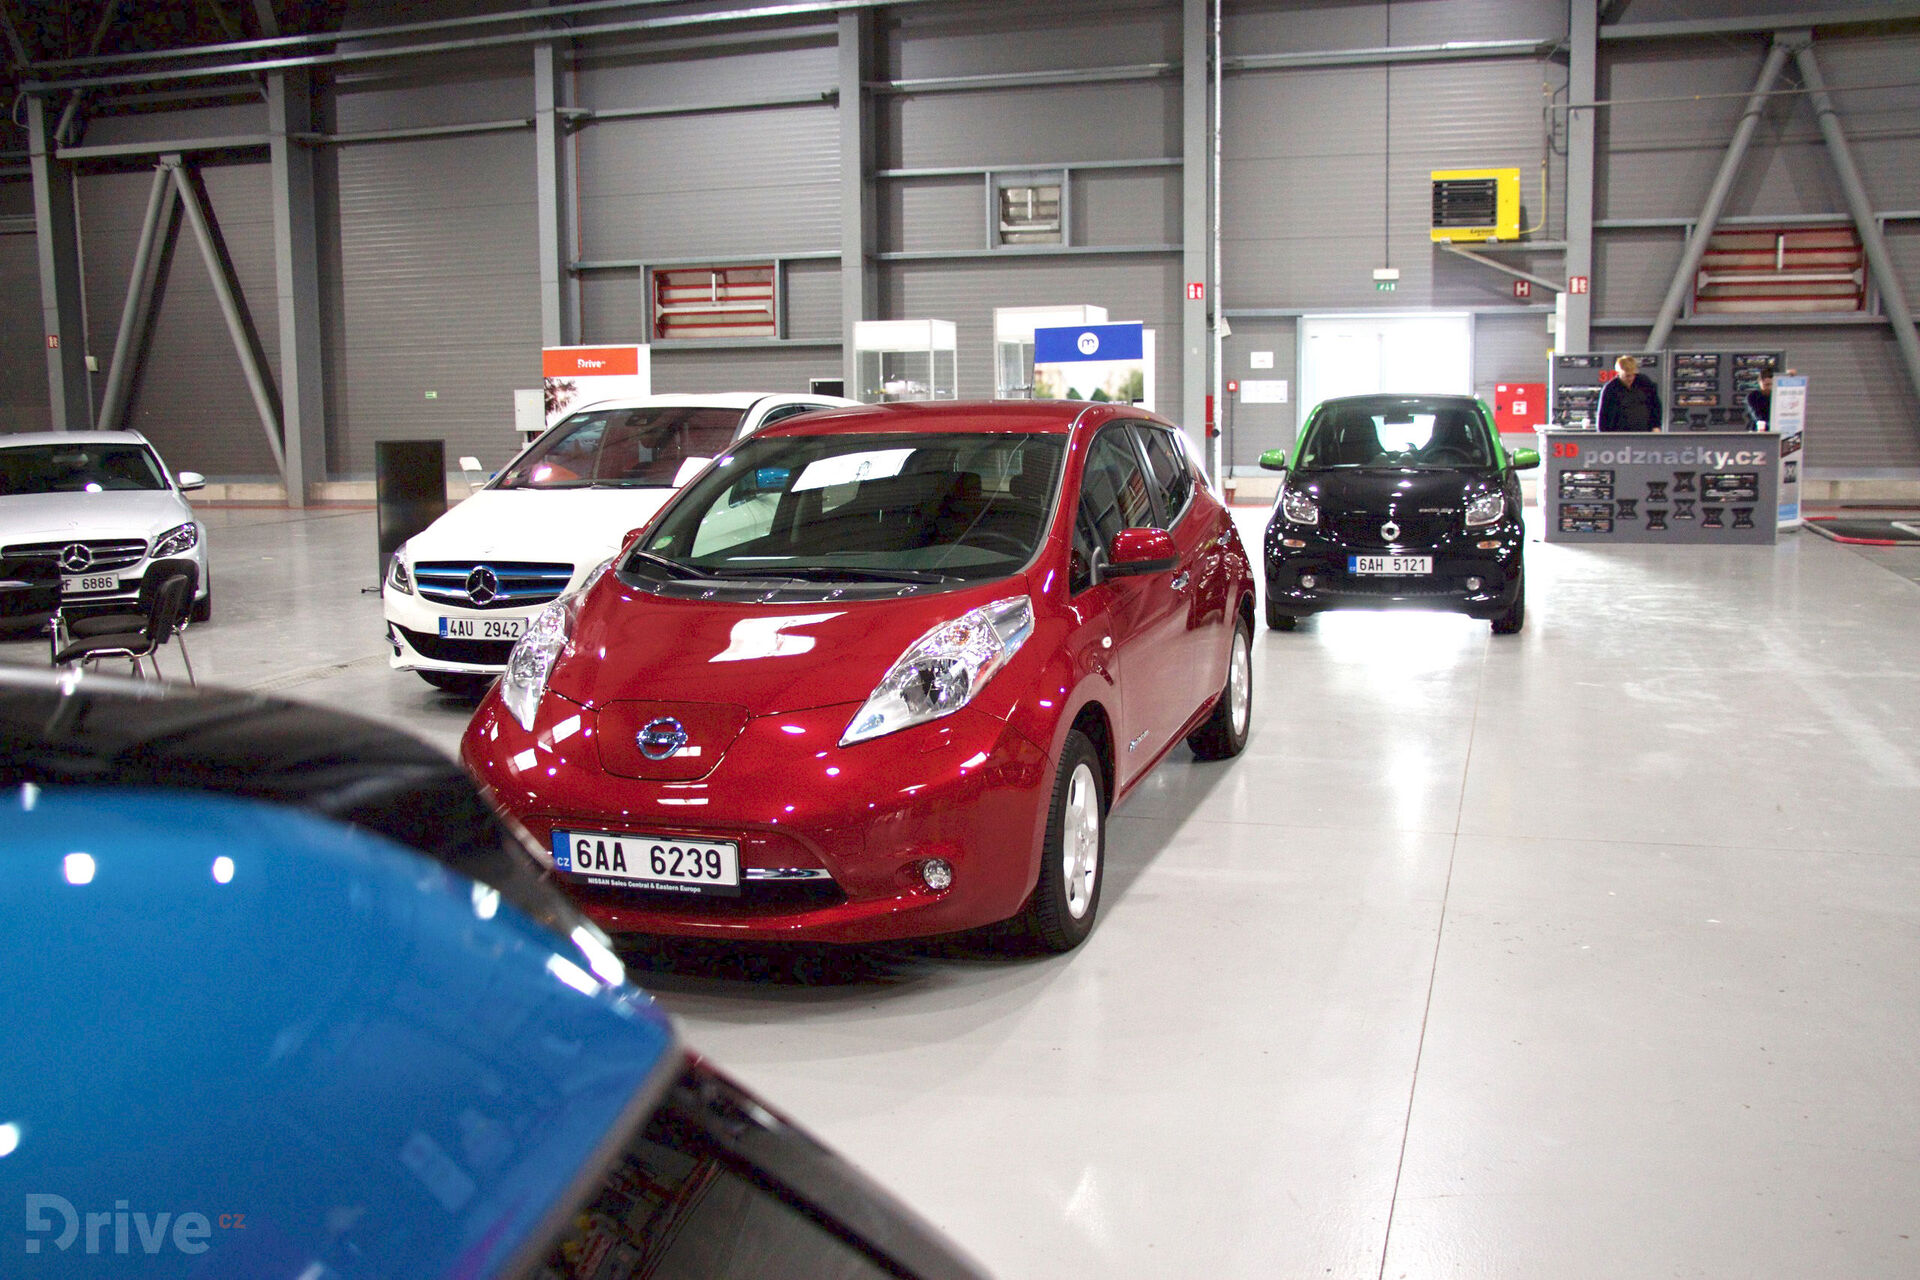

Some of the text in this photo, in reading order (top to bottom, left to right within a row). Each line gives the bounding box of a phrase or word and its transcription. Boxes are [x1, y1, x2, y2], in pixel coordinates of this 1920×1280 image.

[1552, 442, 1767, 470] 3D podznačky.cz
[1359, 558, 1425, 571] 6AH 5121
[82, 576, 113, 590] 6886
[450, 620, 519, 638] 4AU 2942
[556, 857, 570, 867] CZ
[576, 839, 722, 880] 6AA 6239
[588, 877, 610, 886] NISSAN
